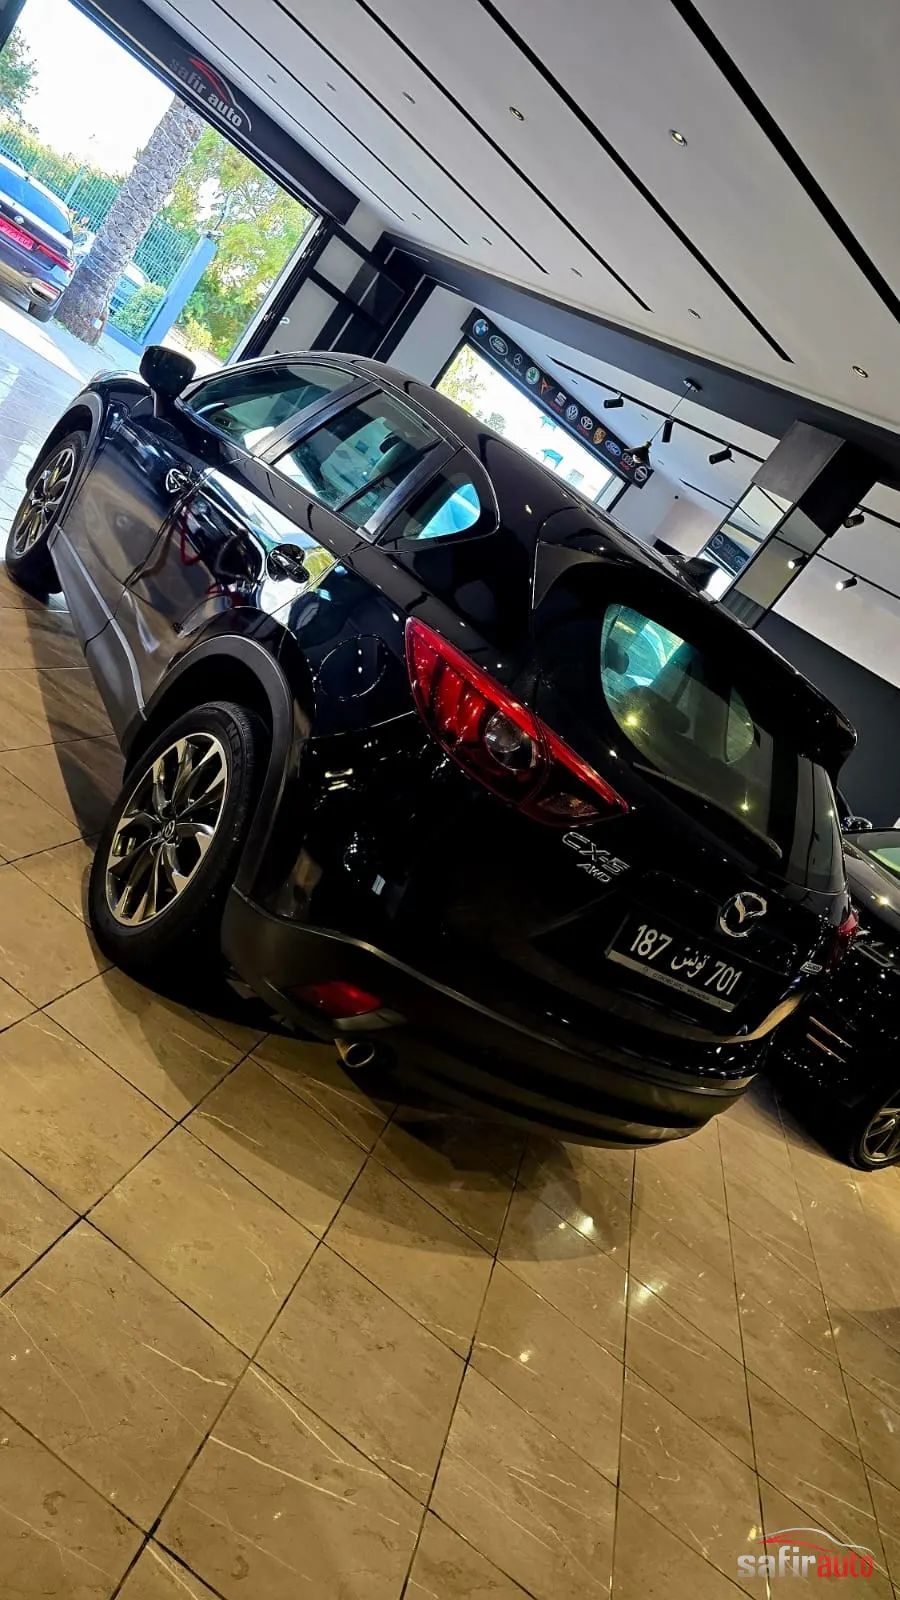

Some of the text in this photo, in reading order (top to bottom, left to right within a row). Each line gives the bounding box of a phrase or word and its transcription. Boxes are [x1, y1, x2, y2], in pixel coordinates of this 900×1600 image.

[170, 59, 242, 127] safir auto
[562, 831, 630, 875] CX-5
[577, 862, 613, 884] AWD
[630, 924, 673, 961] 187
[670, 945, 710, 978] تونس
[704, 961, 743, 996] 701
